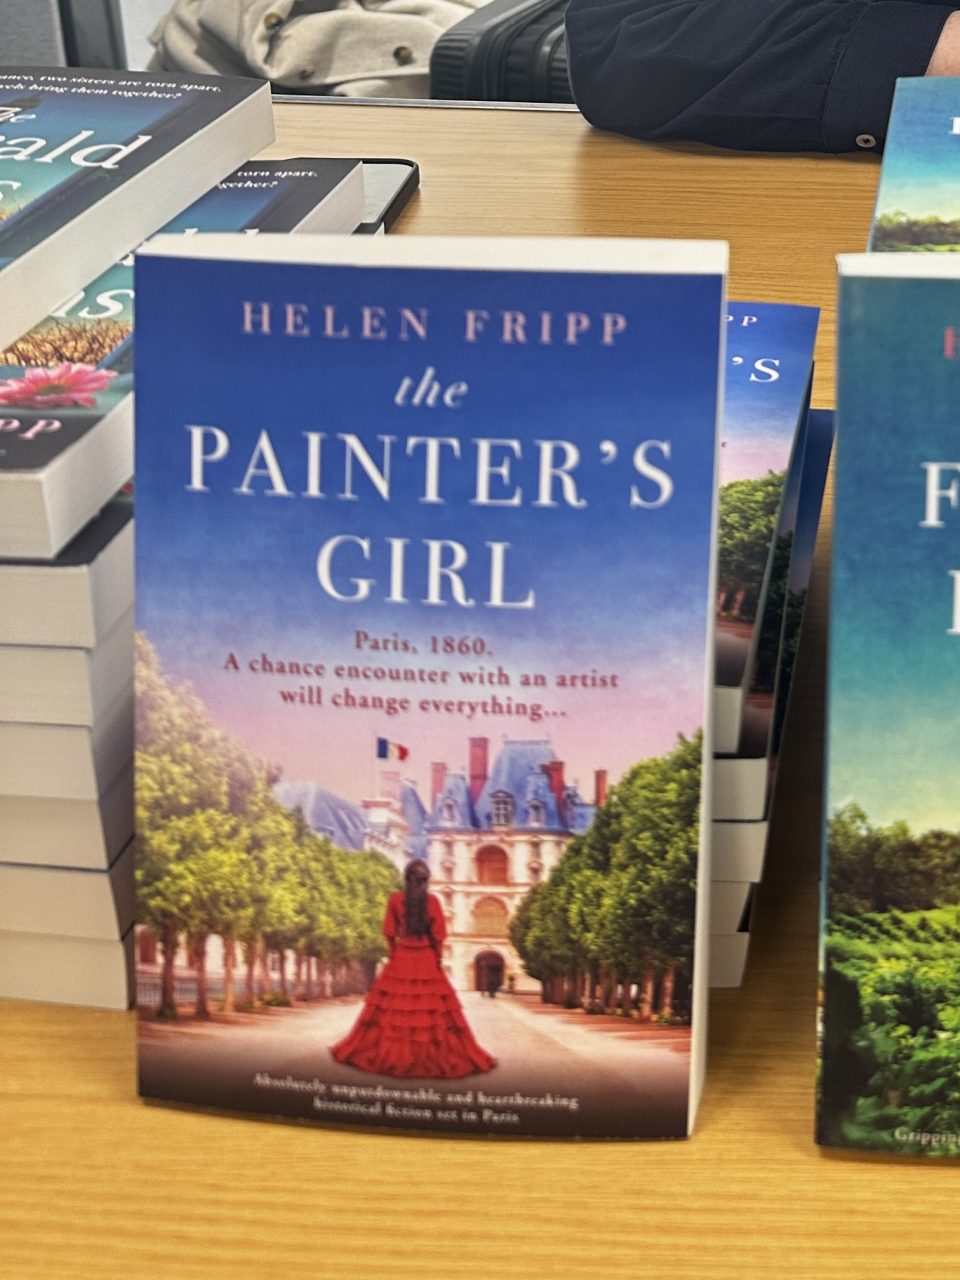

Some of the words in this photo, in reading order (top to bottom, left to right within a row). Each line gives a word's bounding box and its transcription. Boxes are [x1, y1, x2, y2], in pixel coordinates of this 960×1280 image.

[241, 301, 428, 341] HELEN
[463, 309, 628, 347] FRIPP
[394, 365, 469, 409] the
[184, 424, 675, 510] PAINTER'S
[316, 533, 536, 610] GIRL
[354, 630, 418, 655] Paris,
[430, 635, 494, 656] 1860.
[223, 653, 240, 672] A
[249, 655, 325, 677] chance
[334, 665, 449, 684] encounter
[459, 666, 510, 688] with
[519, 673, 546, 687] an
[555, 672, 619, 688] artist
[279, 686, 323, 706] will
[332, 688, 409, 714] change
[313, 1095, 381, 1115] historical
[482, 1108, 520, 1123] Paris
[446, 1090, 473, 1104] and
[476, 1090, 580, 1111] heartbreaking
